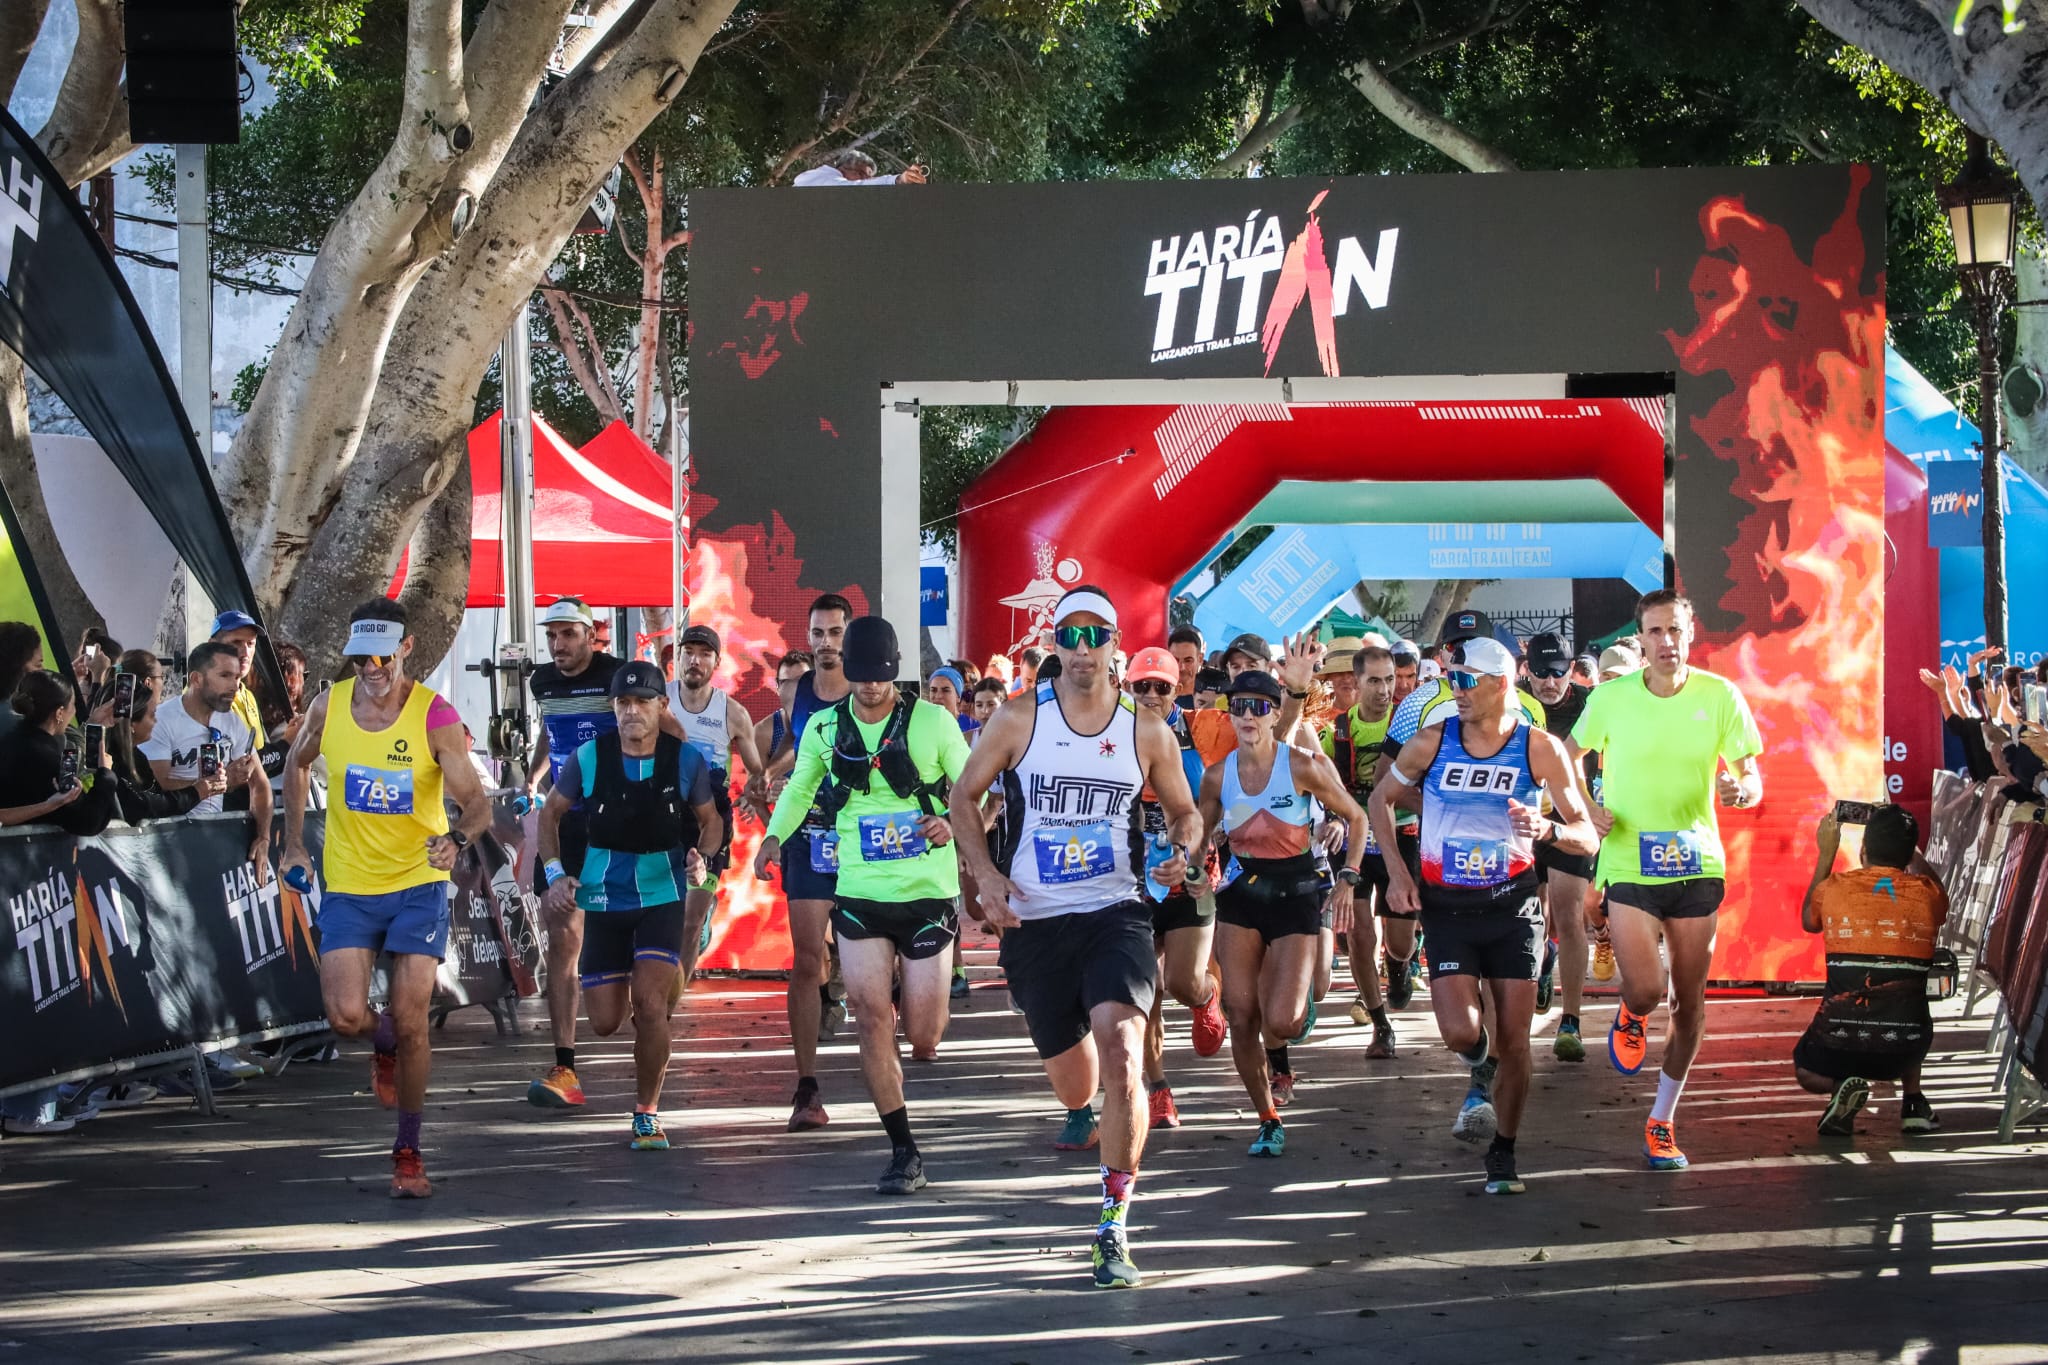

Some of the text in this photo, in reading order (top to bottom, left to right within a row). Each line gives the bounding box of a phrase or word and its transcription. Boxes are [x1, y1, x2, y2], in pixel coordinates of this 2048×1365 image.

[1147, 208, 1285, 277] HARÍA
[1151, 332, 1258, 363] LANZAROTE TRAIL RACE
[1430, 549, 1550, 566] HARIA TRAIL TEAM
[360, 623, 375, 633] RIGO
[387, 754, 413, 763] PALEO
[1445, 768, 1515, 791] EBR
[357, 780, 400, 801] 763
[870, 826, 914, 847] 502
[1048, 839, 1099, 866] 792
[1454, 851, 1498, 871] 594
[1650, 845, 1692, 863] 623
[222, 859, 277, 904] HARA
[9, 866, 73, 932] HARÍA
